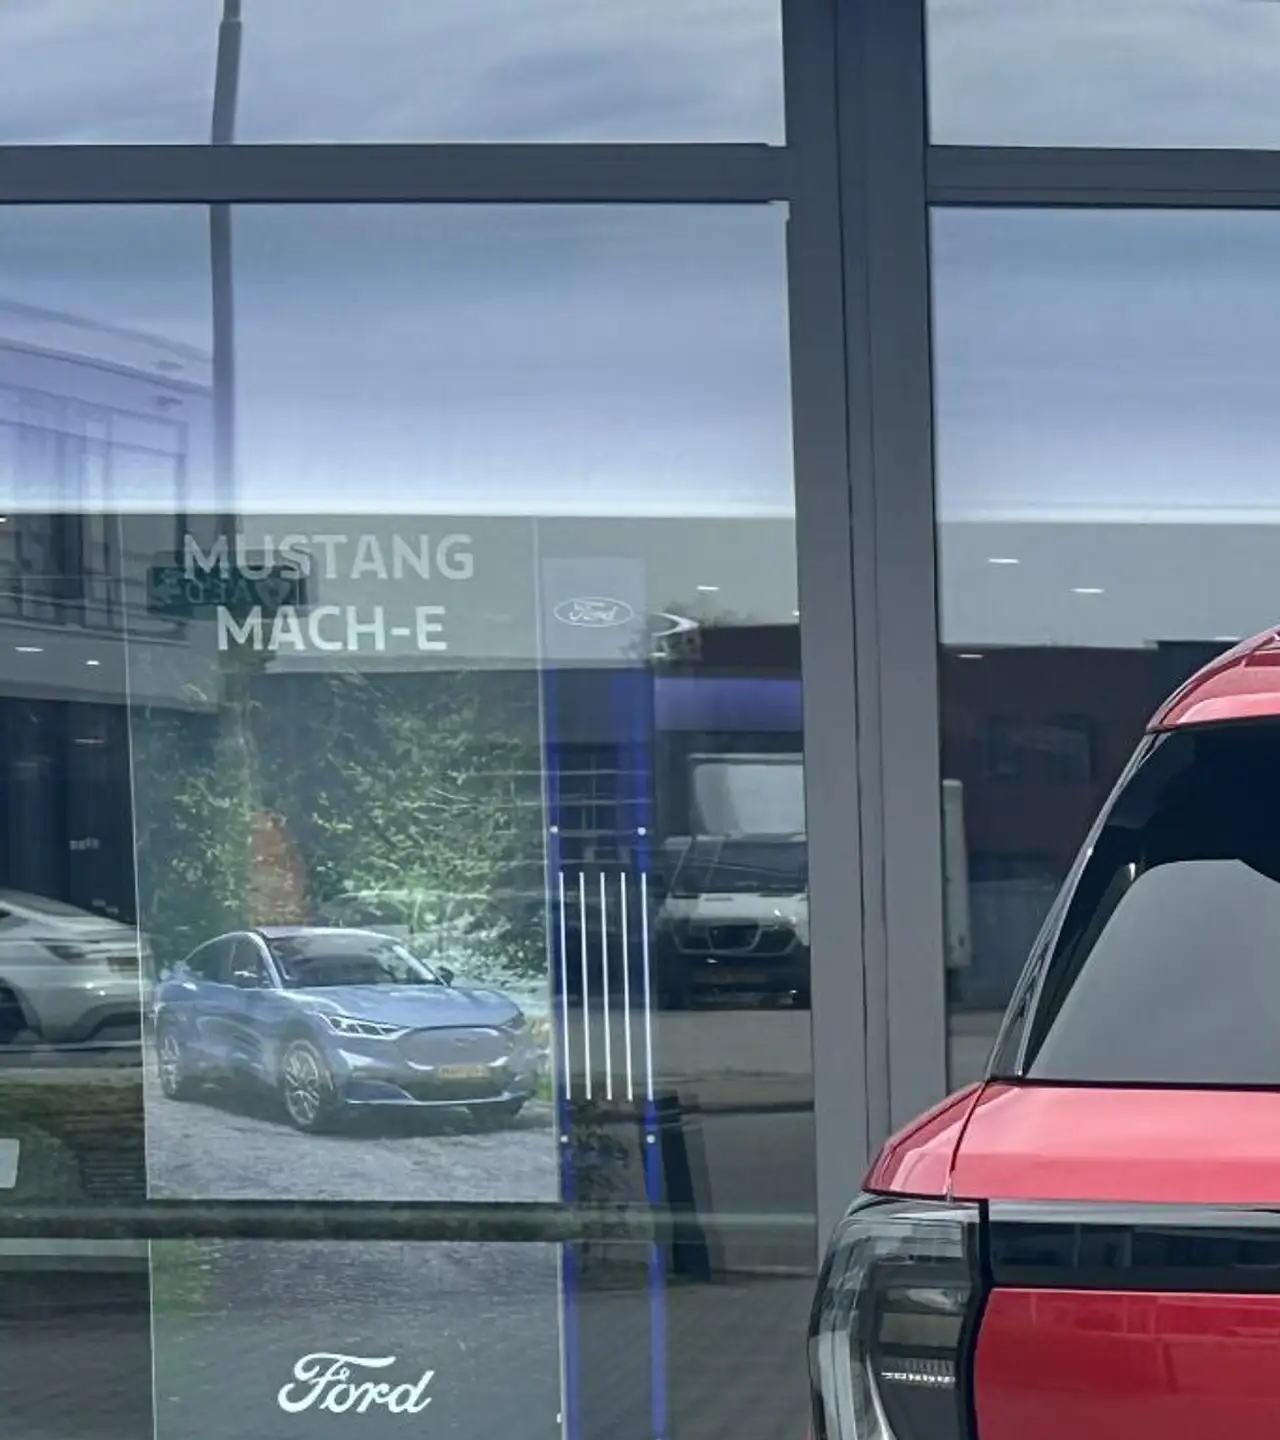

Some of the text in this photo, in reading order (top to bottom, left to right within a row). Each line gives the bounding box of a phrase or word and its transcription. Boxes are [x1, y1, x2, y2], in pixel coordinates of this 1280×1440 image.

[182, 533, 474, 581] MUSTANG
[216, 606, 447, 651] MACH-E
[277, 1352, 435, 1413] Ford
